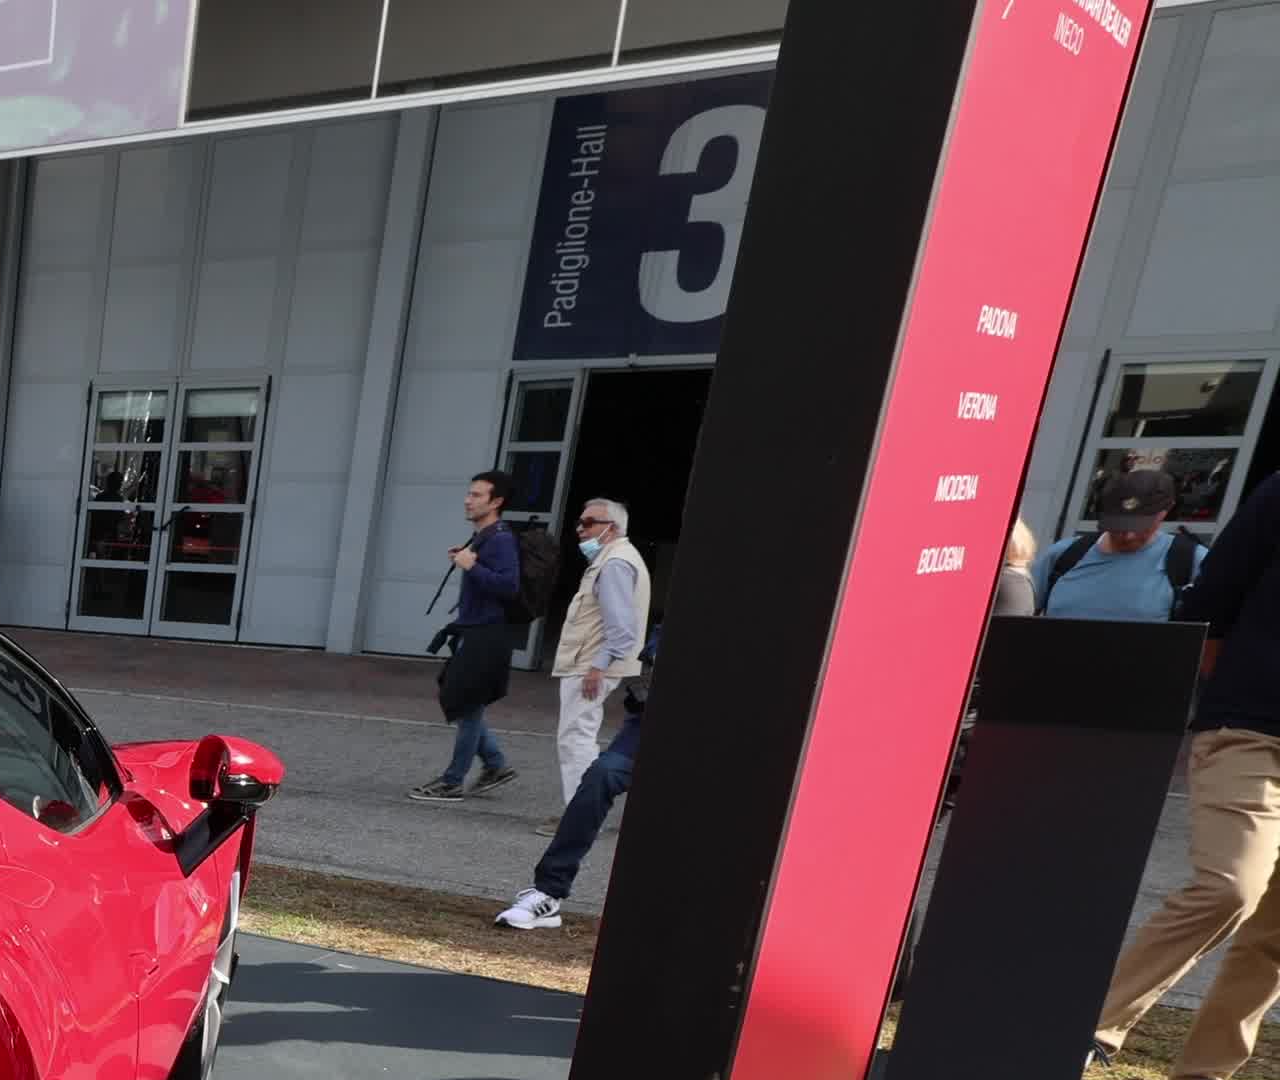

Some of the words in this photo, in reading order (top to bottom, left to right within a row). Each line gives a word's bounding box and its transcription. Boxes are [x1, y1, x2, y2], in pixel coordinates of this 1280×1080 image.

[1054, 12, 1085, 56] INECO
[543, 123, 609, 329] Padiglione-Hall
[638, 104, 767, 323] 3
[976, 304, 1018, 340] PADOVA
[957, 391, 998, 421] VERONA
[934, 474, 979, 503] MODENA
[916, 546, 966, 575] BOLOGNA
